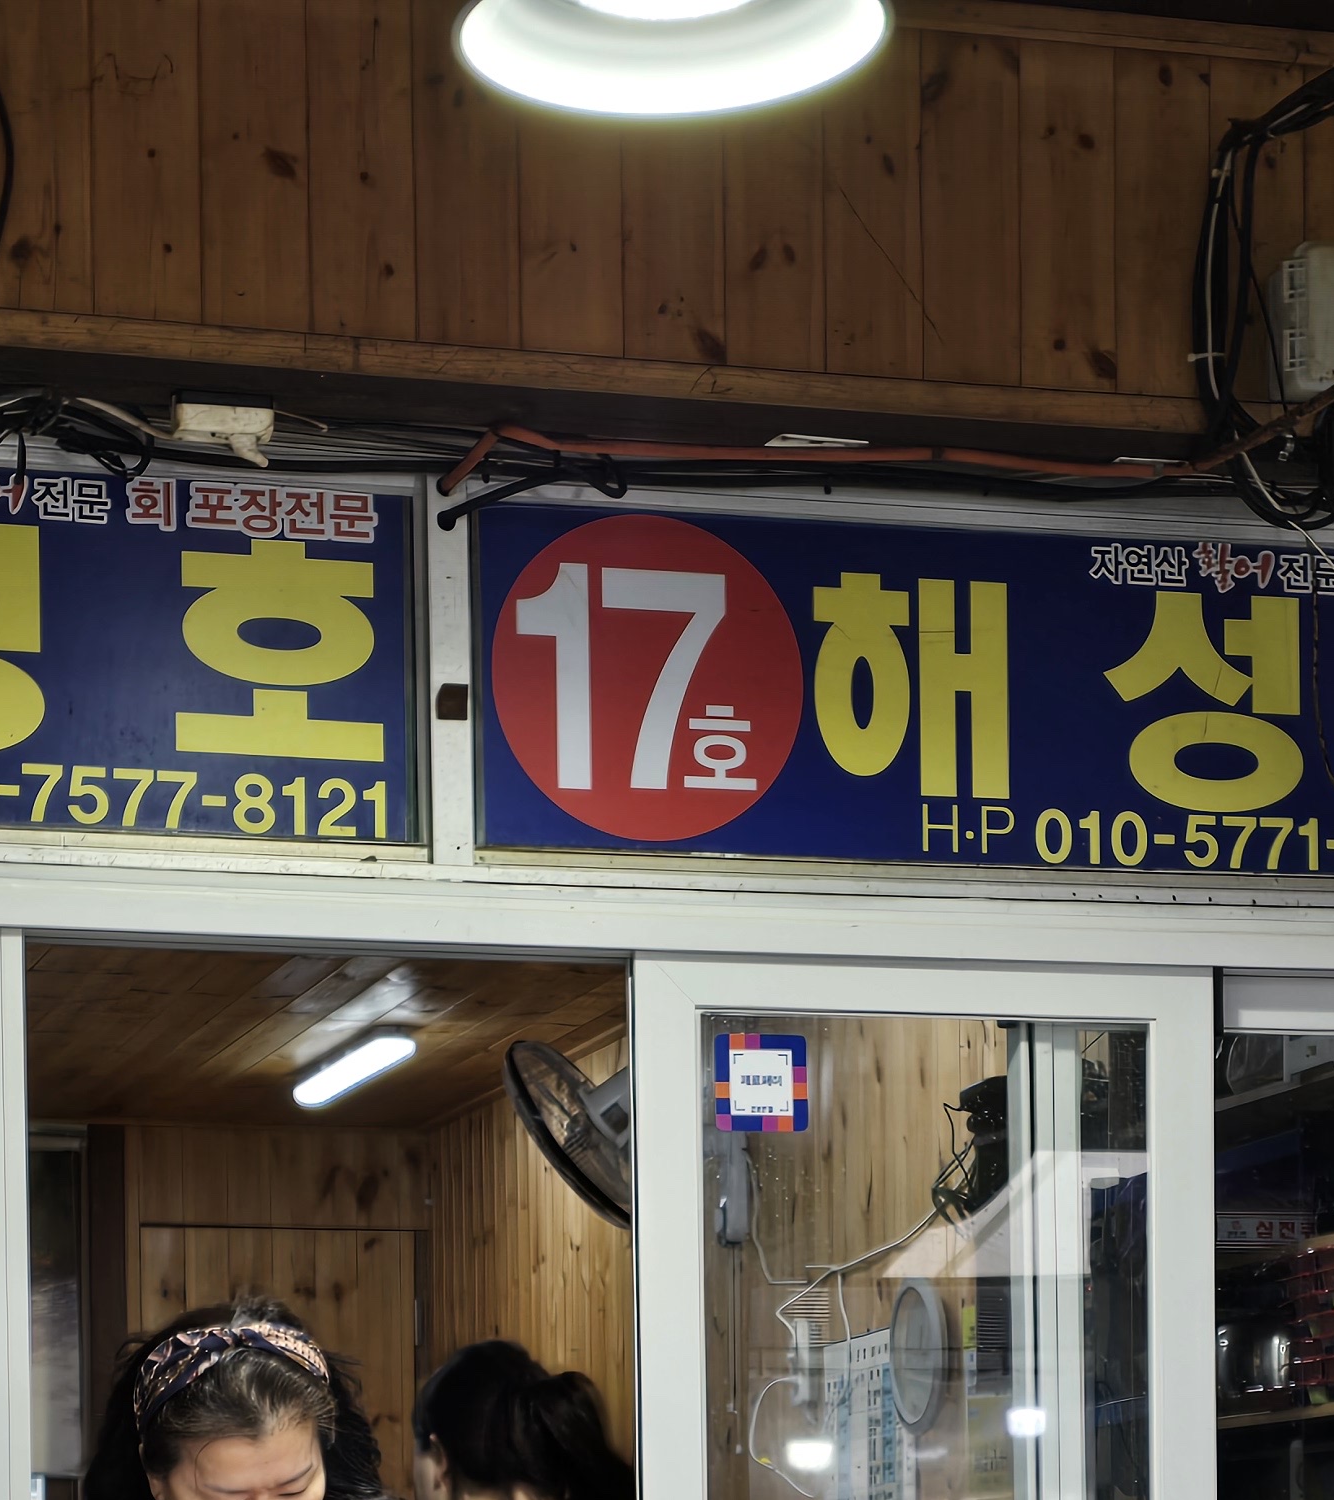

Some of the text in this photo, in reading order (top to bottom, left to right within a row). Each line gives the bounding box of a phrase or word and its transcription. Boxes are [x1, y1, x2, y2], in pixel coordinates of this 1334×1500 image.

[31, 478, 110, 523] 전문
[126, 476, 176, 530] 회
[187, 480, 378, 541] 포장전문
[1089, 543, 1190, 587] 자연산
[1193, 541, 1274, 594] 활어
